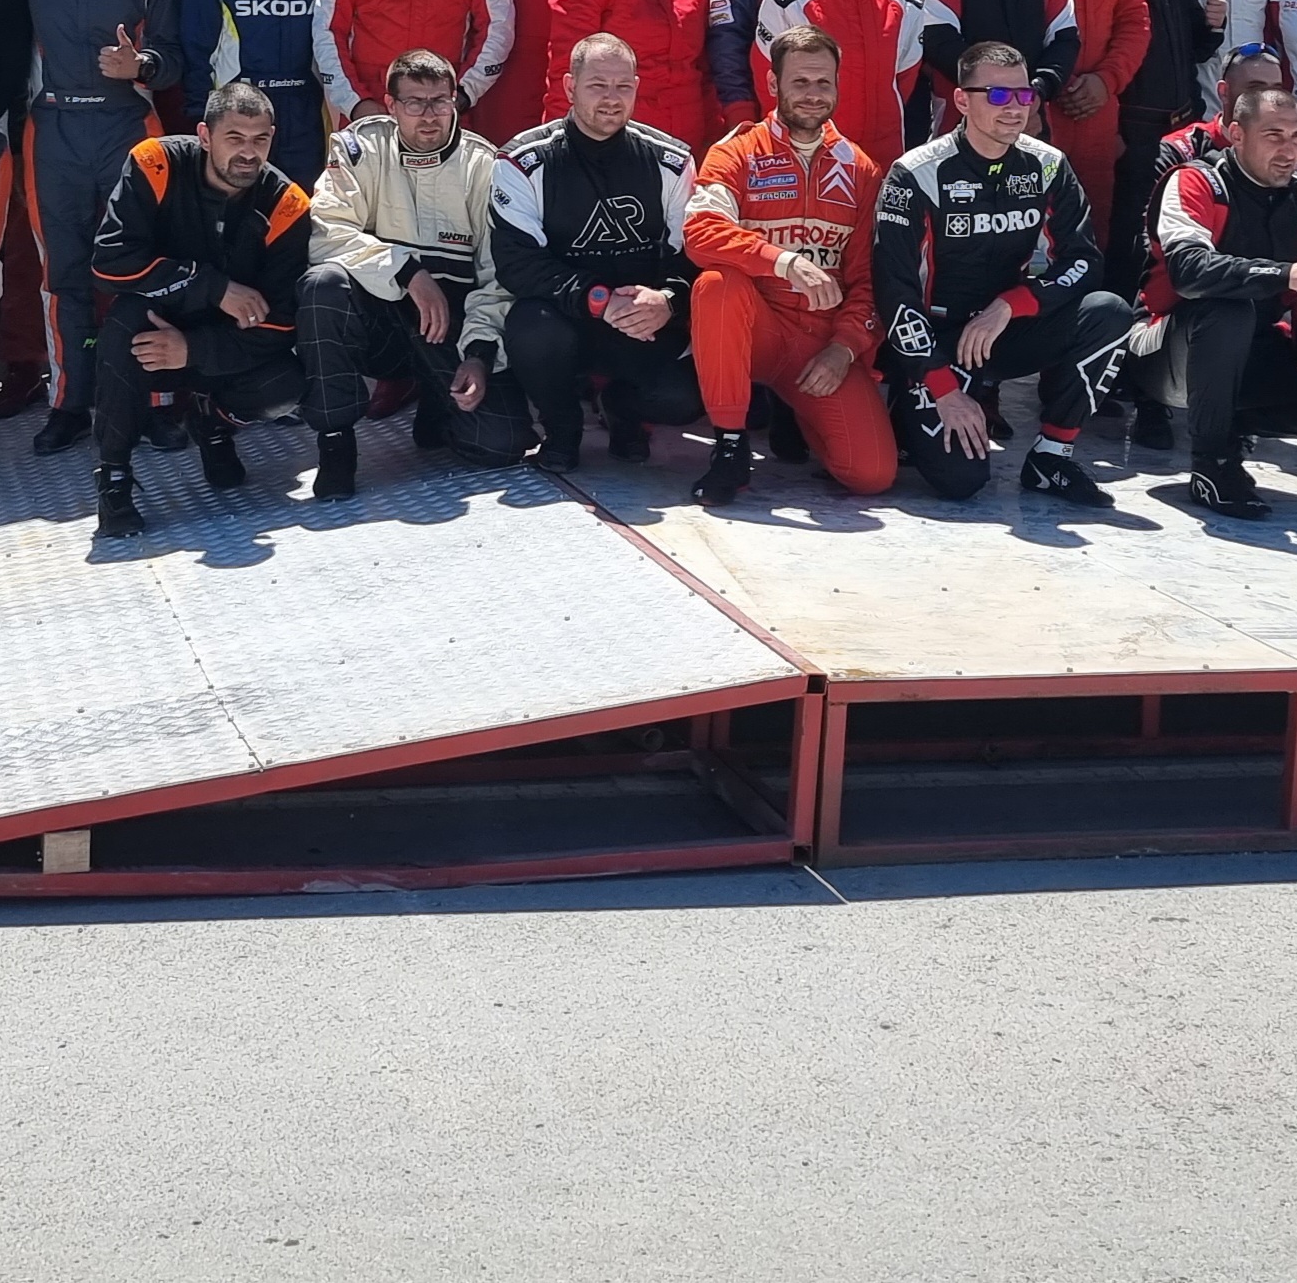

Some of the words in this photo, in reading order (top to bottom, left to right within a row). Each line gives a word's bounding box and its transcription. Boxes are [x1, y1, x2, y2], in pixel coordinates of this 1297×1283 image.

[758, 158, 791, 168] TOTAL
[973, 208, 1041, 234] BORO
[1057, 259, 1090, 288] ORO
